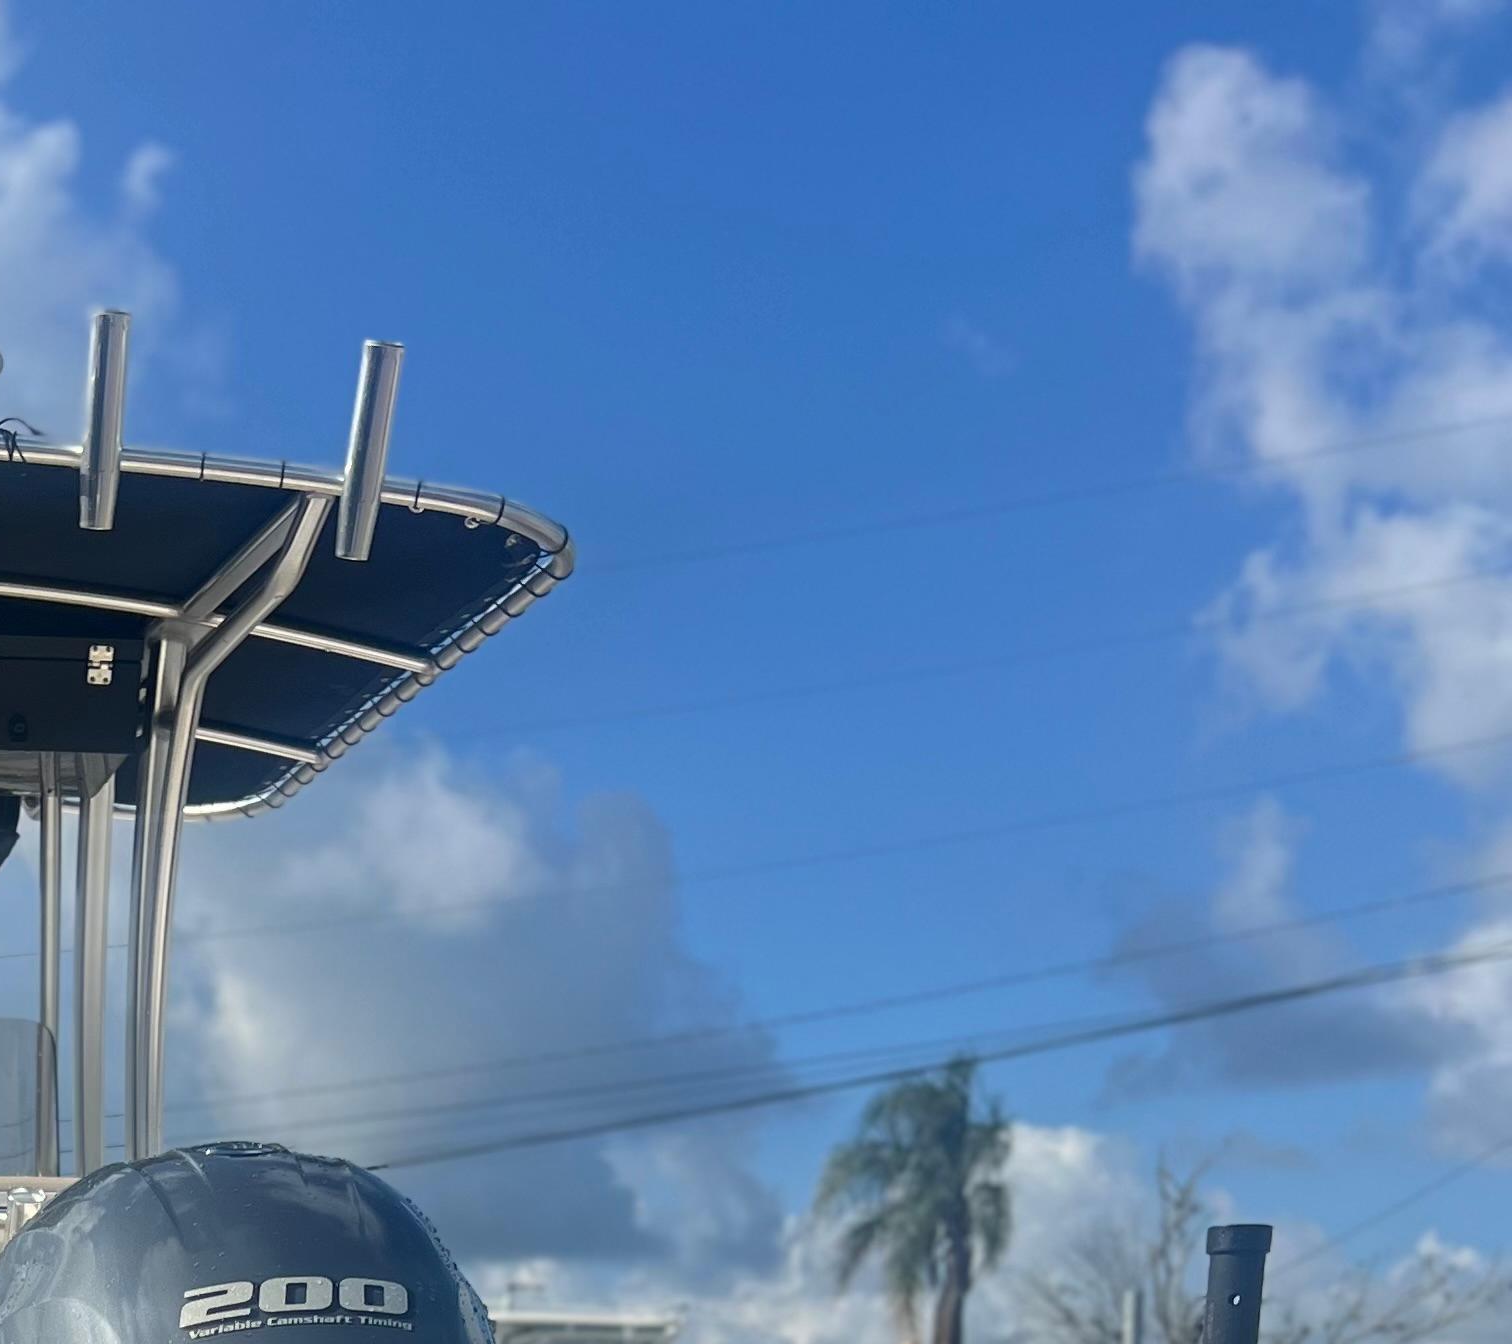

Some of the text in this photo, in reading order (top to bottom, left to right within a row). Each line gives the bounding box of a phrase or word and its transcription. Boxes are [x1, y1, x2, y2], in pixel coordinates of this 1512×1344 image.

[179, 1276, 408, 1328] 200
[189, 1314, 413, 1340] Variable Camshaft Timing
